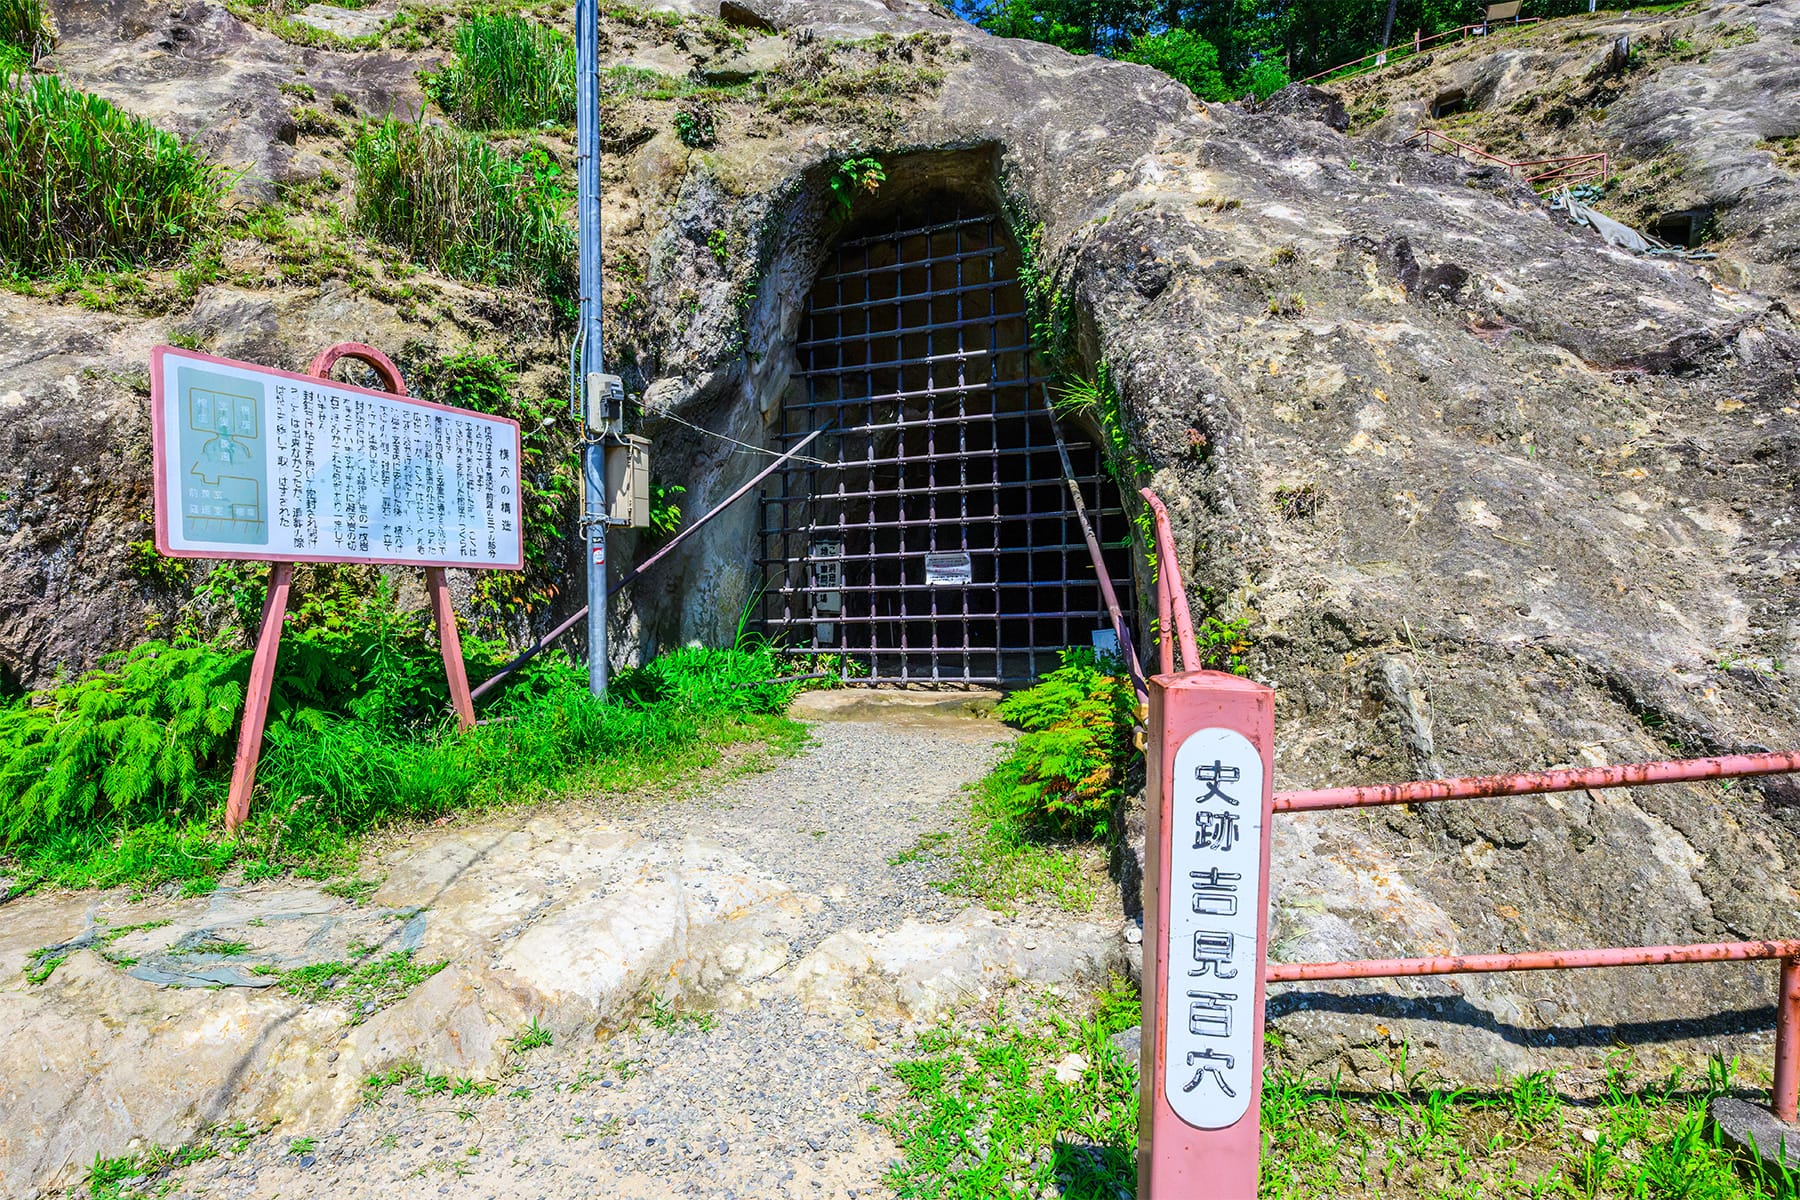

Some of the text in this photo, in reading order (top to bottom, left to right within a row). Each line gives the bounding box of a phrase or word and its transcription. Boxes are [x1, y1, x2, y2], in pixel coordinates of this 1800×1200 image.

[1182, 760, 1242, 1098] 史跡吉見百穴
